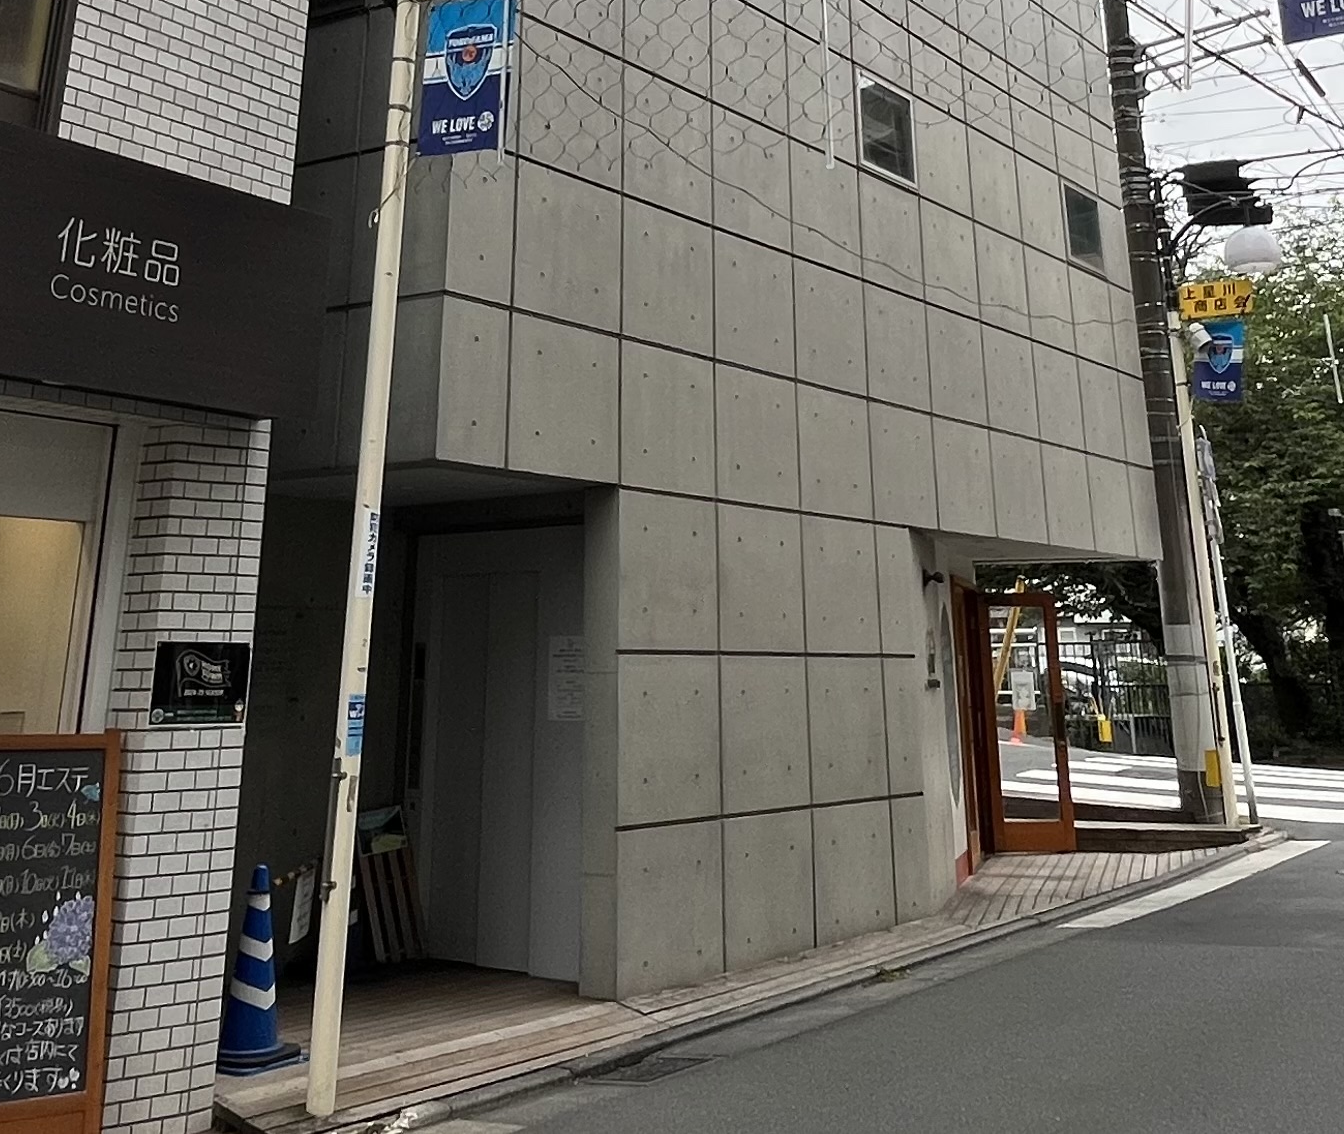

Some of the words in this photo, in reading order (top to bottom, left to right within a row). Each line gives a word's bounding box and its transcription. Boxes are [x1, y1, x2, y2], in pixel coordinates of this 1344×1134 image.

[432, 119, 448, 134] WE
[449, 116, 476, 133] LOVE
[57, 217, 181, 287] 化粧品
[50, 273, 180, 323] Cosmetics
